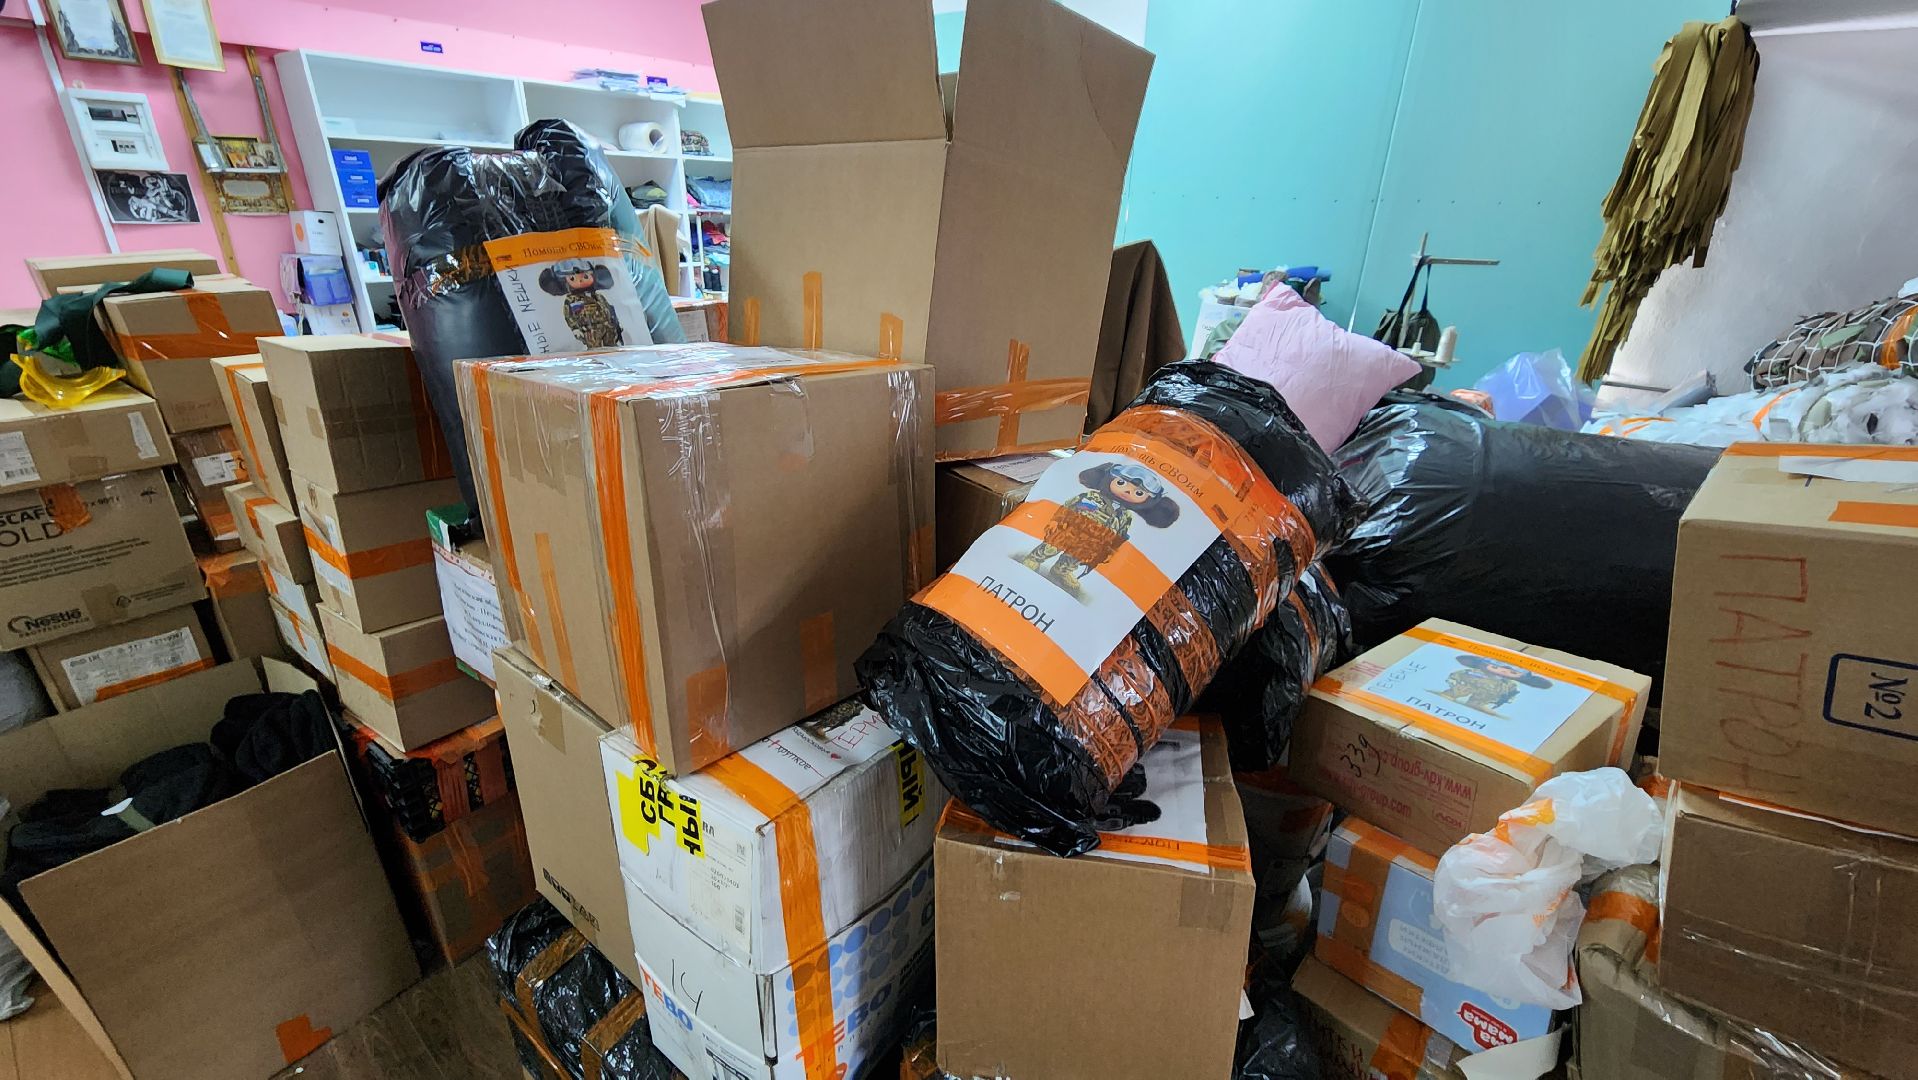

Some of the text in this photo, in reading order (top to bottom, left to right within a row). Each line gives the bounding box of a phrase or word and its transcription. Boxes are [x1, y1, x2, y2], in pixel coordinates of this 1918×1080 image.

[1158, 461, 1204, 499] СВОим
[977, 575, 1055, 633] ПАТРОН
[1709, 554, 1812, 794] ПАТРОН
[1405, 695, 1488, 731] ПАТРОН
